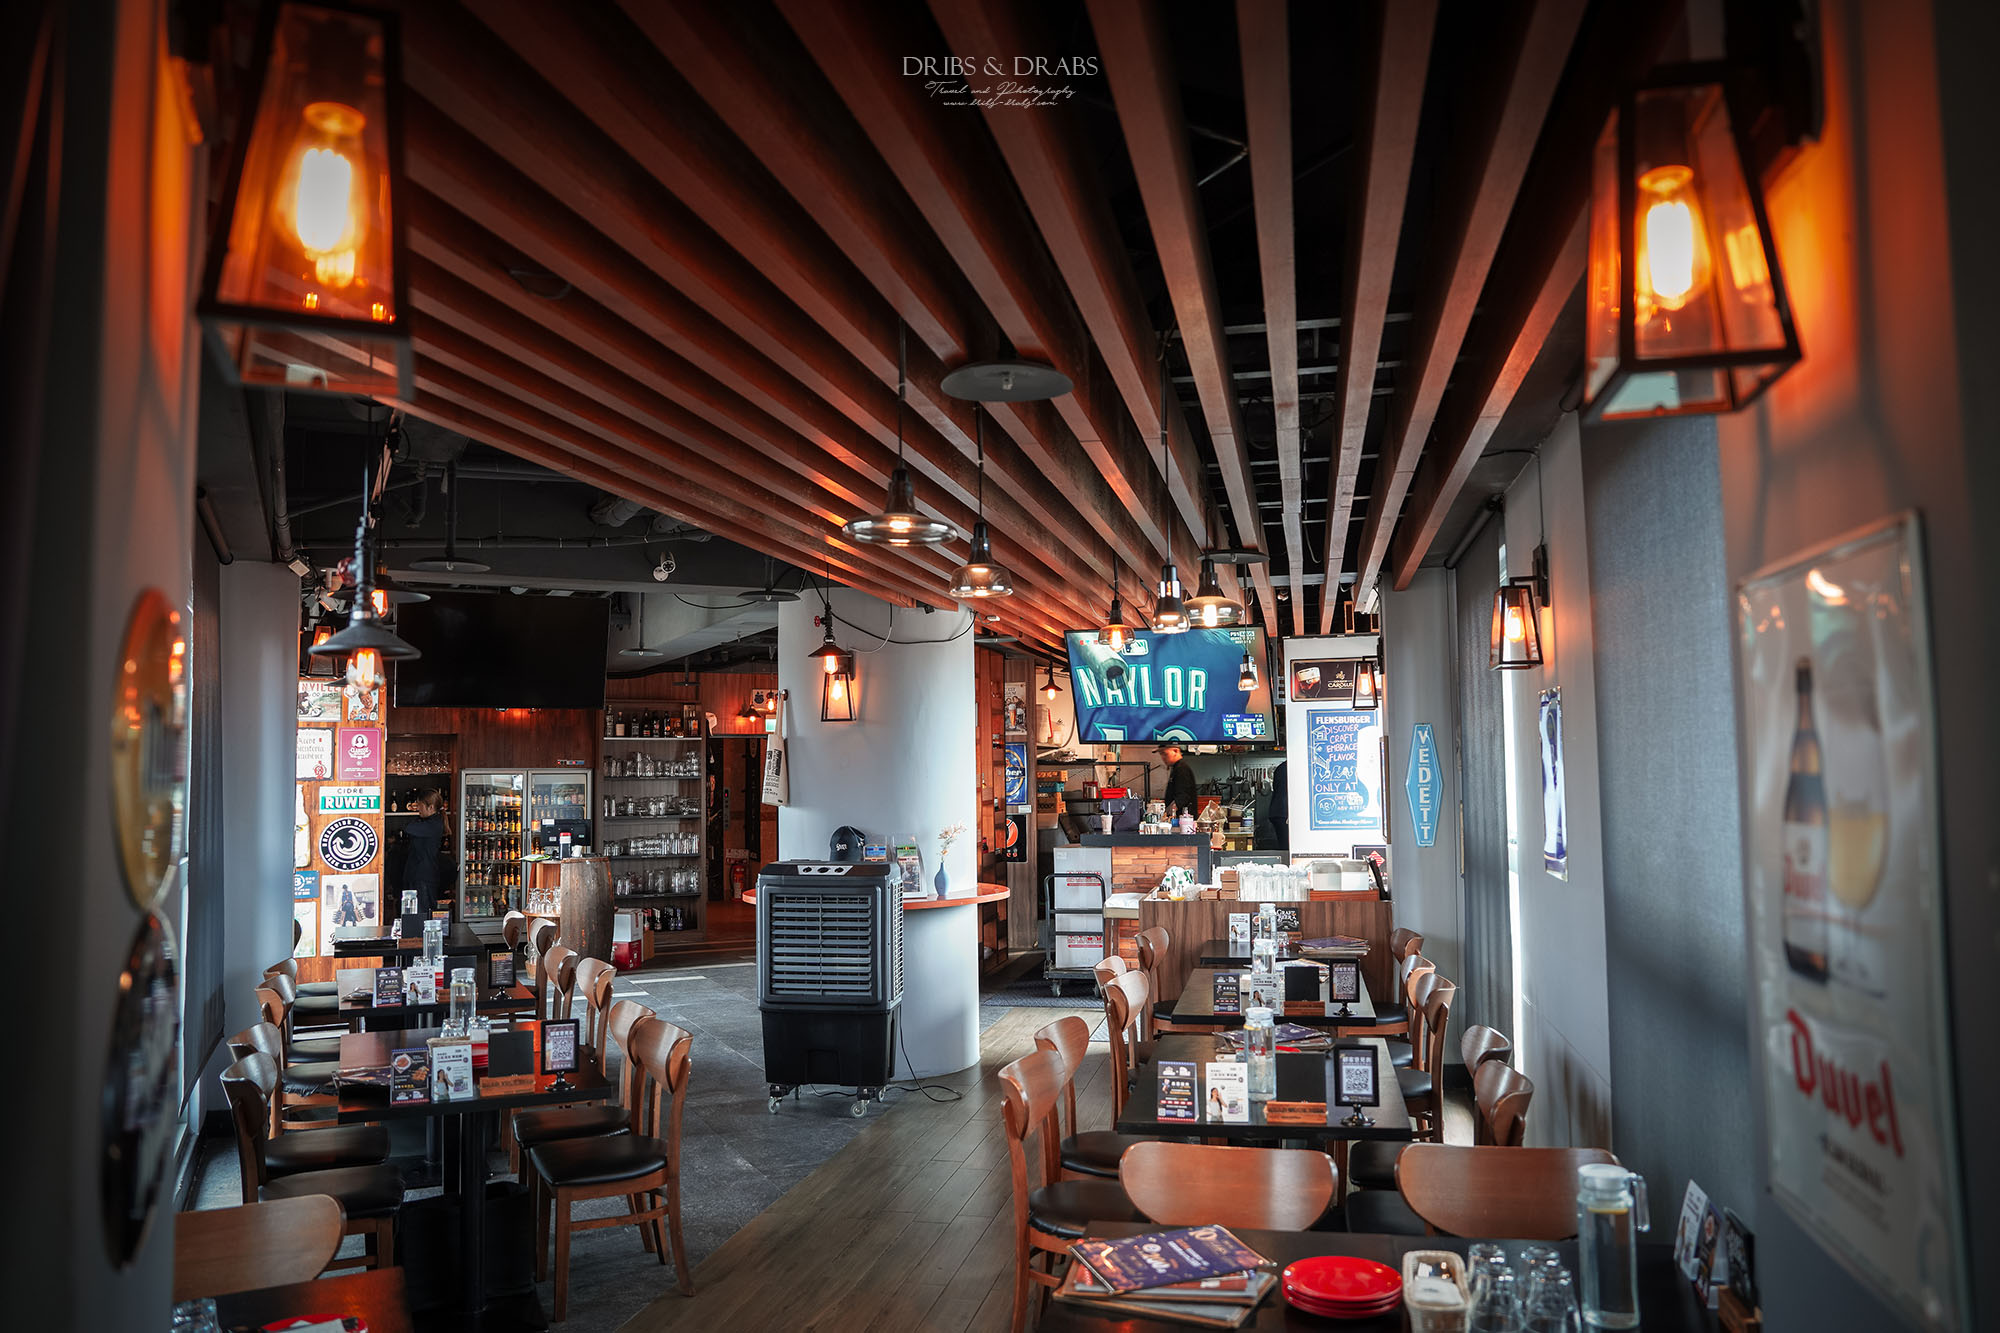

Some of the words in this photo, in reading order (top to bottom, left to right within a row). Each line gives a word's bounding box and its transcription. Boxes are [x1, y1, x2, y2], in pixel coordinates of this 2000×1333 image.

[1074, 663, 1209, 712] NAYLOR
[1316, 715, 1371, 725] FLENSBURGER
[1325, 724, 1360, 736] DISCOVER
[1326, 743, 1358, 753] EMBRACE
[1315, 783, 1341, 793] ONLY
[1345, 782, 1357, 792] AT
[1418, 730, 1431, 840] VEDETT
[324, 795, 377, 809] RUWET
[354, 820, 375, 846] BREWERY
[1786, 1006, 1906, 1159] Duvel
